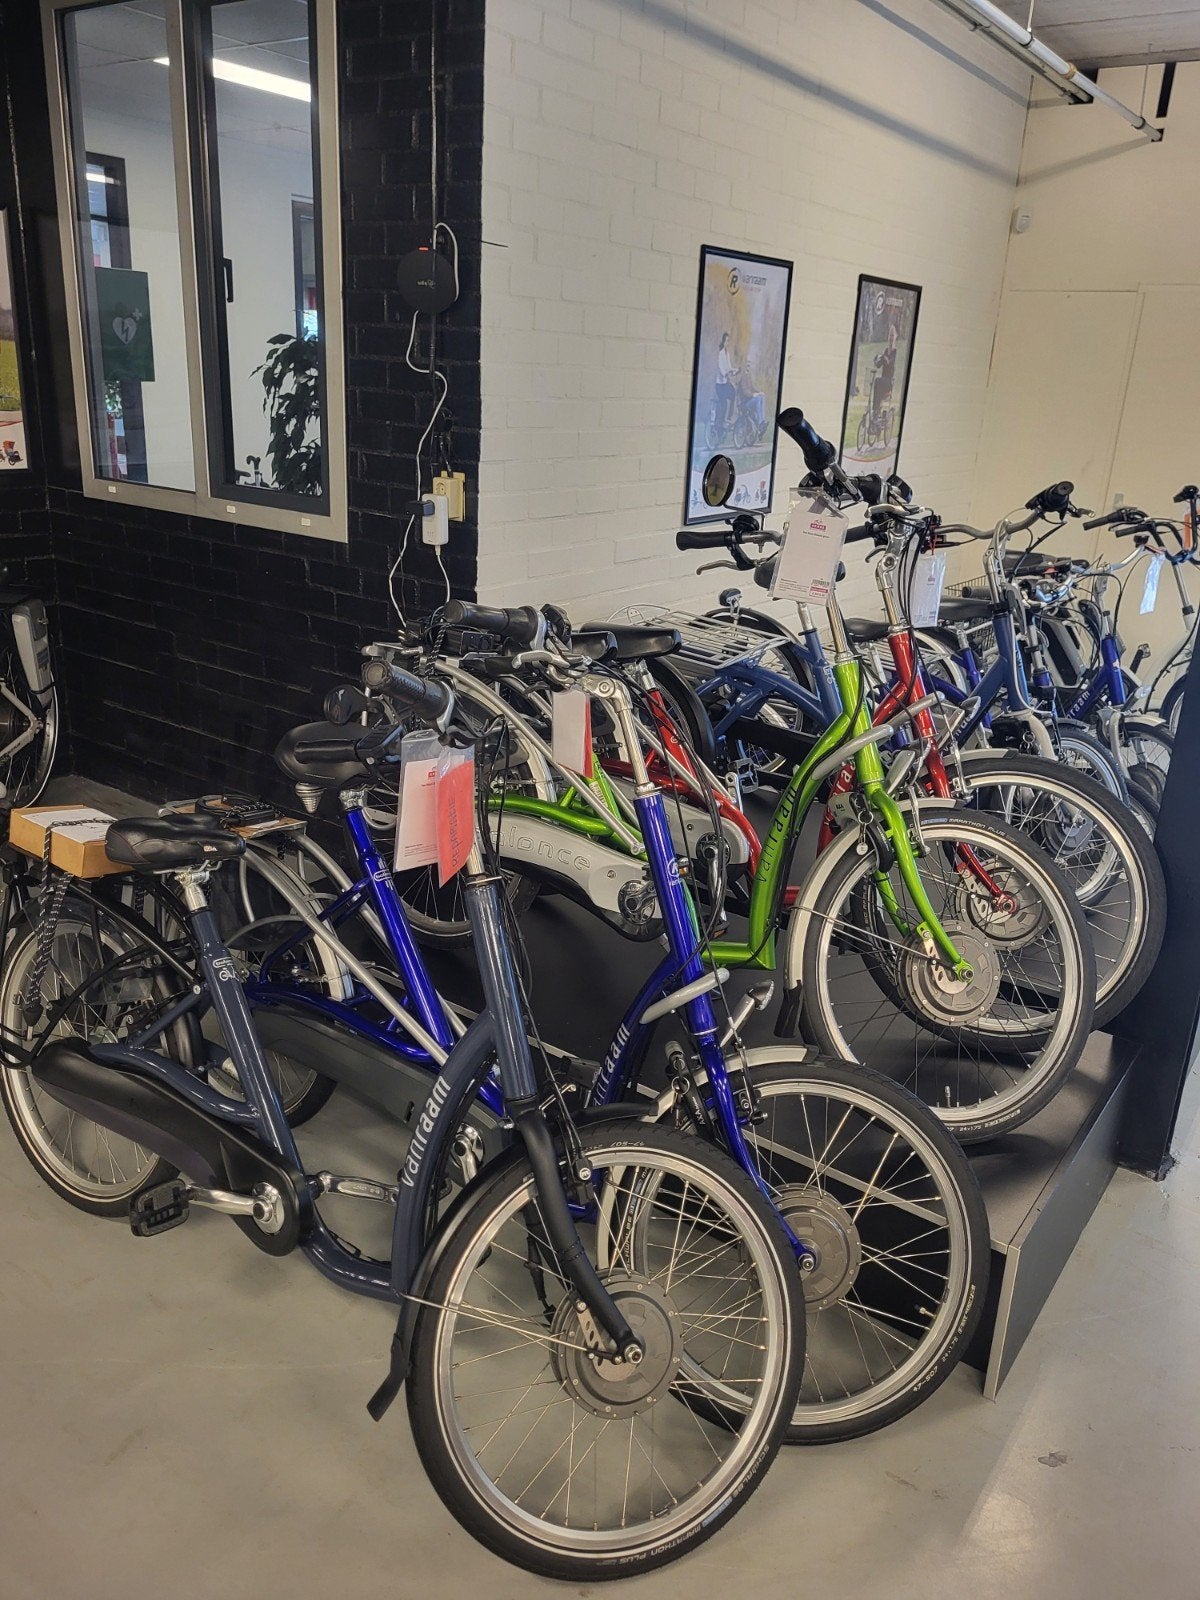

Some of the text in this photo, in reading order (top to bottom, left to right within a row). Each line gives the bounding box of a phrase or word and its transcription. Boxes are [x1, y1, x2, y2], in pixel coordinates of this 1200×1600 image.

[402, 1075, 451, 1187] vanraam
[619, 1524, 702, 1565] MARATHON PLUS
